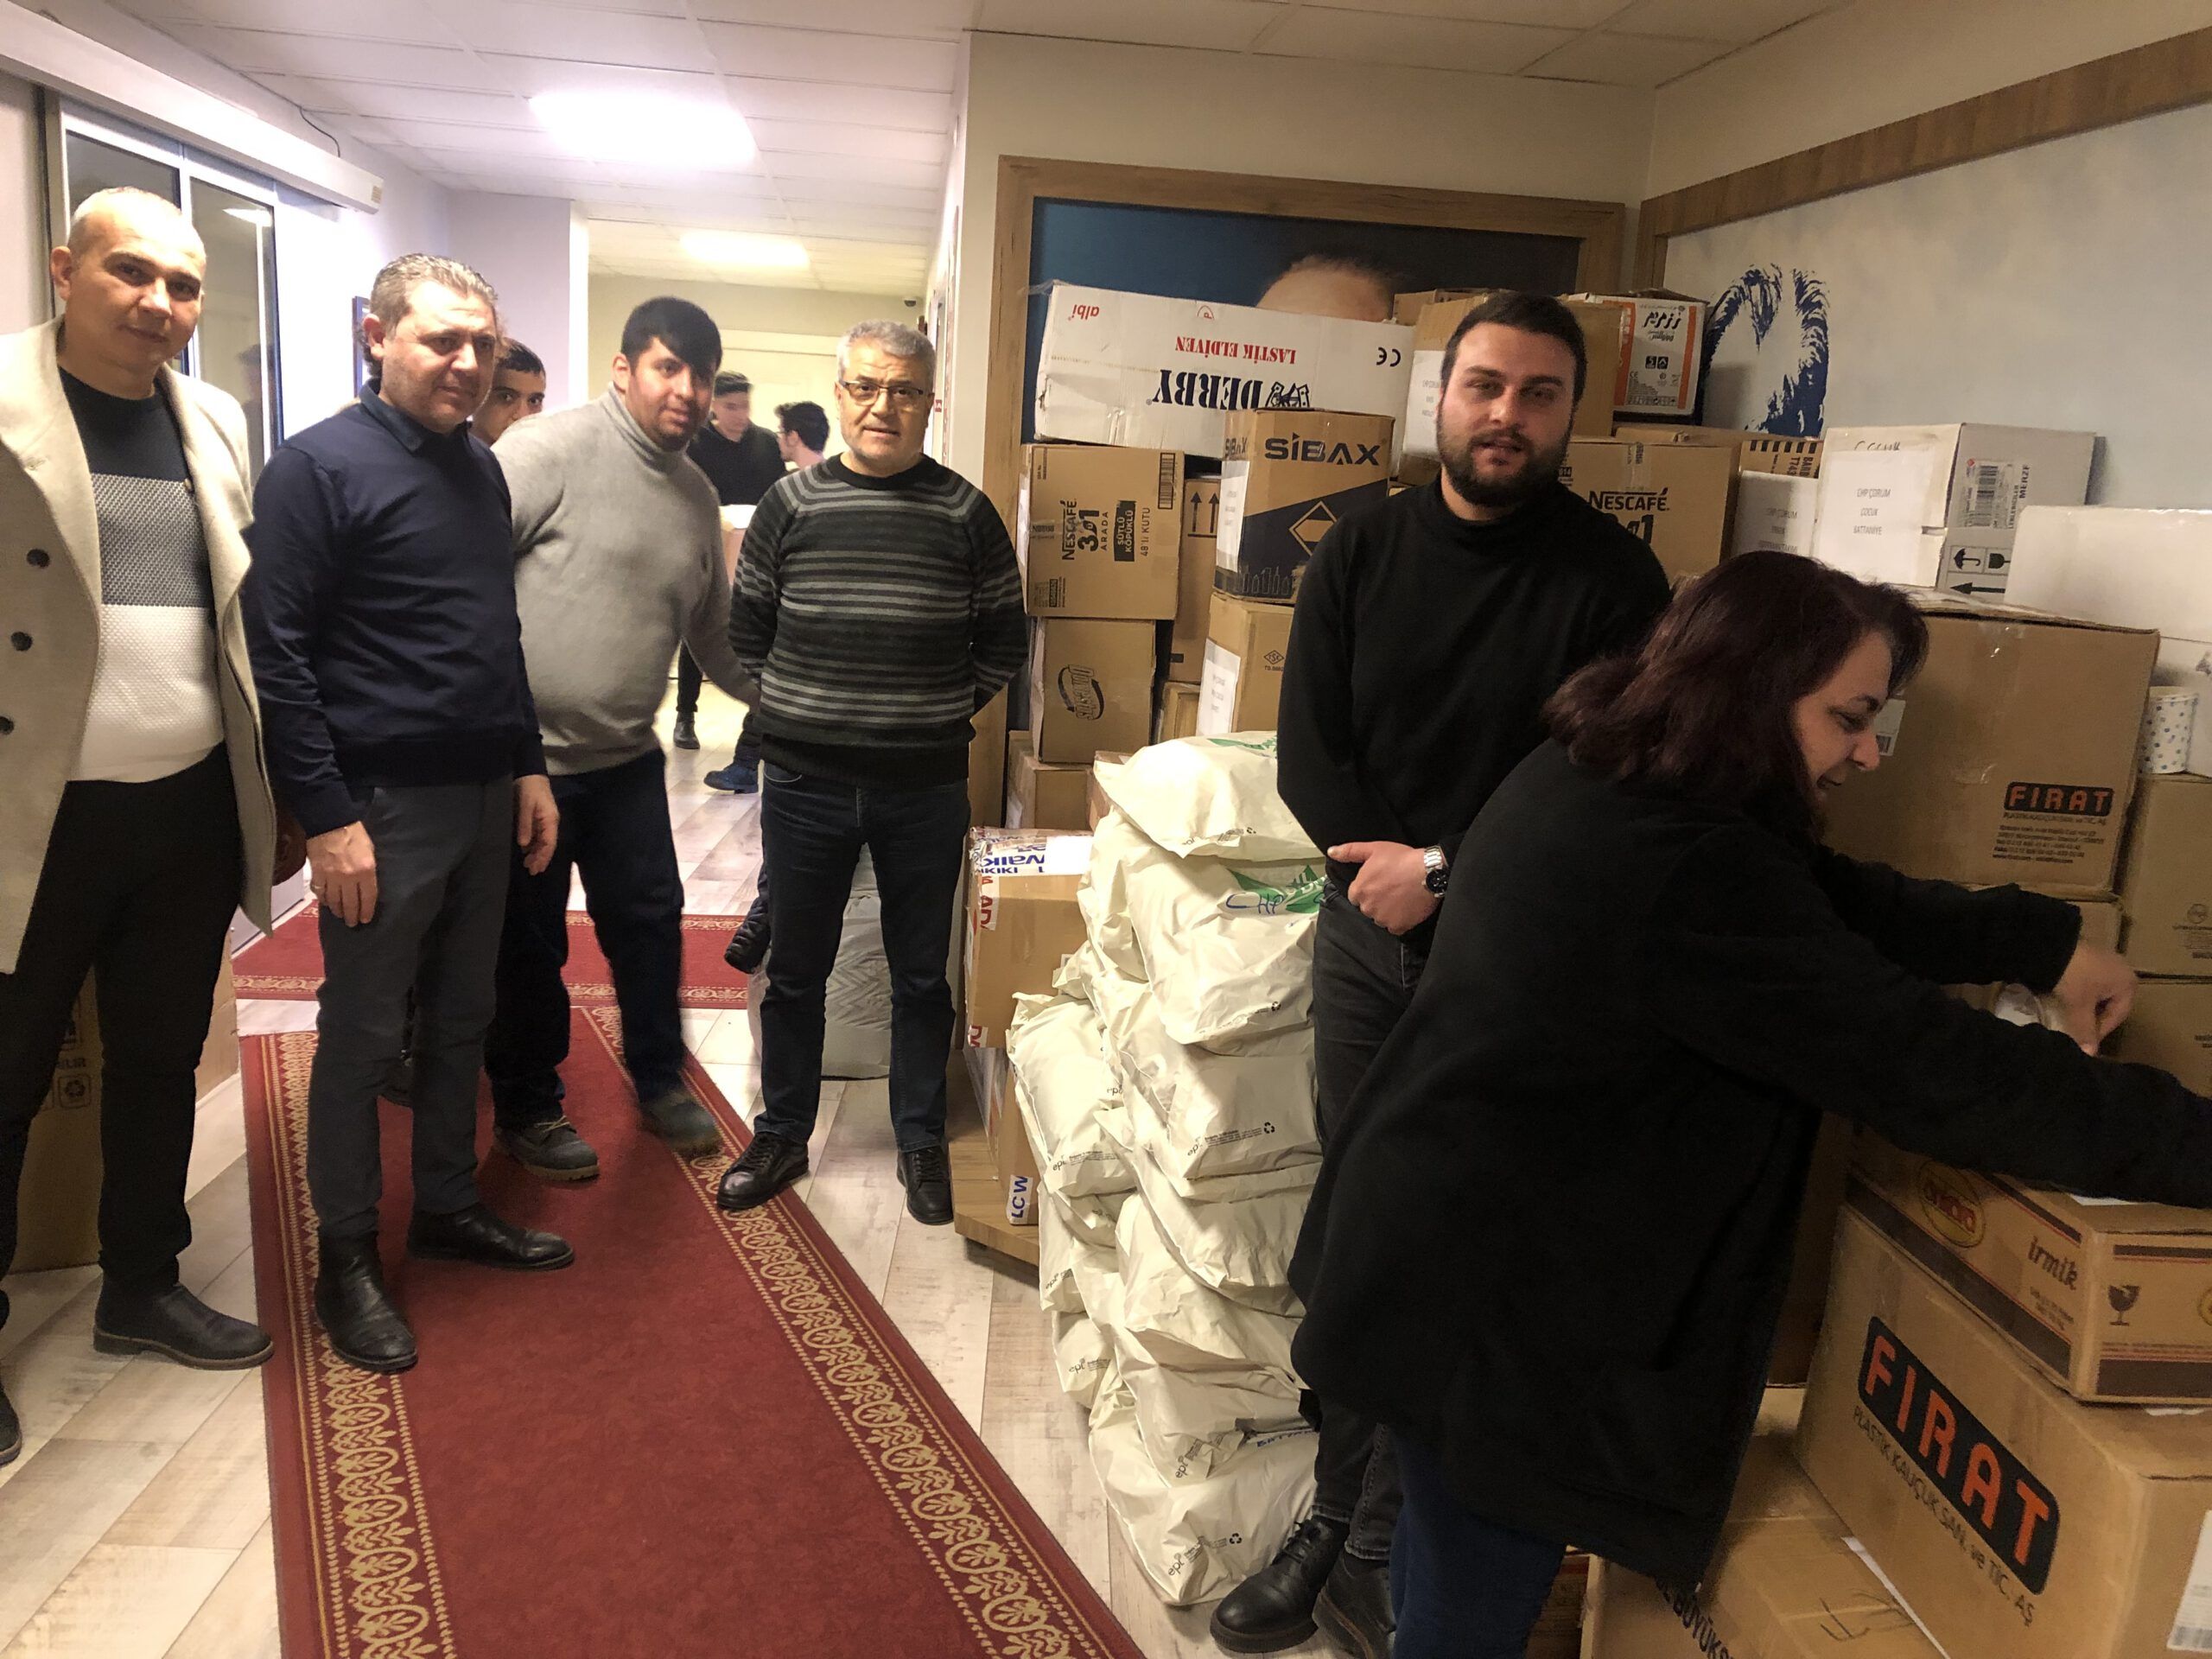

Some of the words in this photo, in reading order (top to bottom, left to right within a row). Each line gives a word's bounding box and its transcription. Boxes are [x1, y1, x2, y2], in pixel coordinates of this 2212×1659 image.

[1071, 304, 1100, 321] albi
[1175, 335, 1239, 359] ELDİVEN
[1243, 343, 1296, 365] LASTİK
[1153, 369, 1263, 410] DERBY
[1588, 487, 1669, 511] NESCAFÉ
[1060, 499, 1077, 560] NESCAFÉ
[1116, 516, 1125, 546] SÜTLÜ
[1124, 509, 1134, 553] KÖPÜKLÜ
[1141, 507, 1150, 533] KUTU
[2008, 785, 2110, 813] FIRAT
[1864, 1335, 2050, 1566] FIRAT
